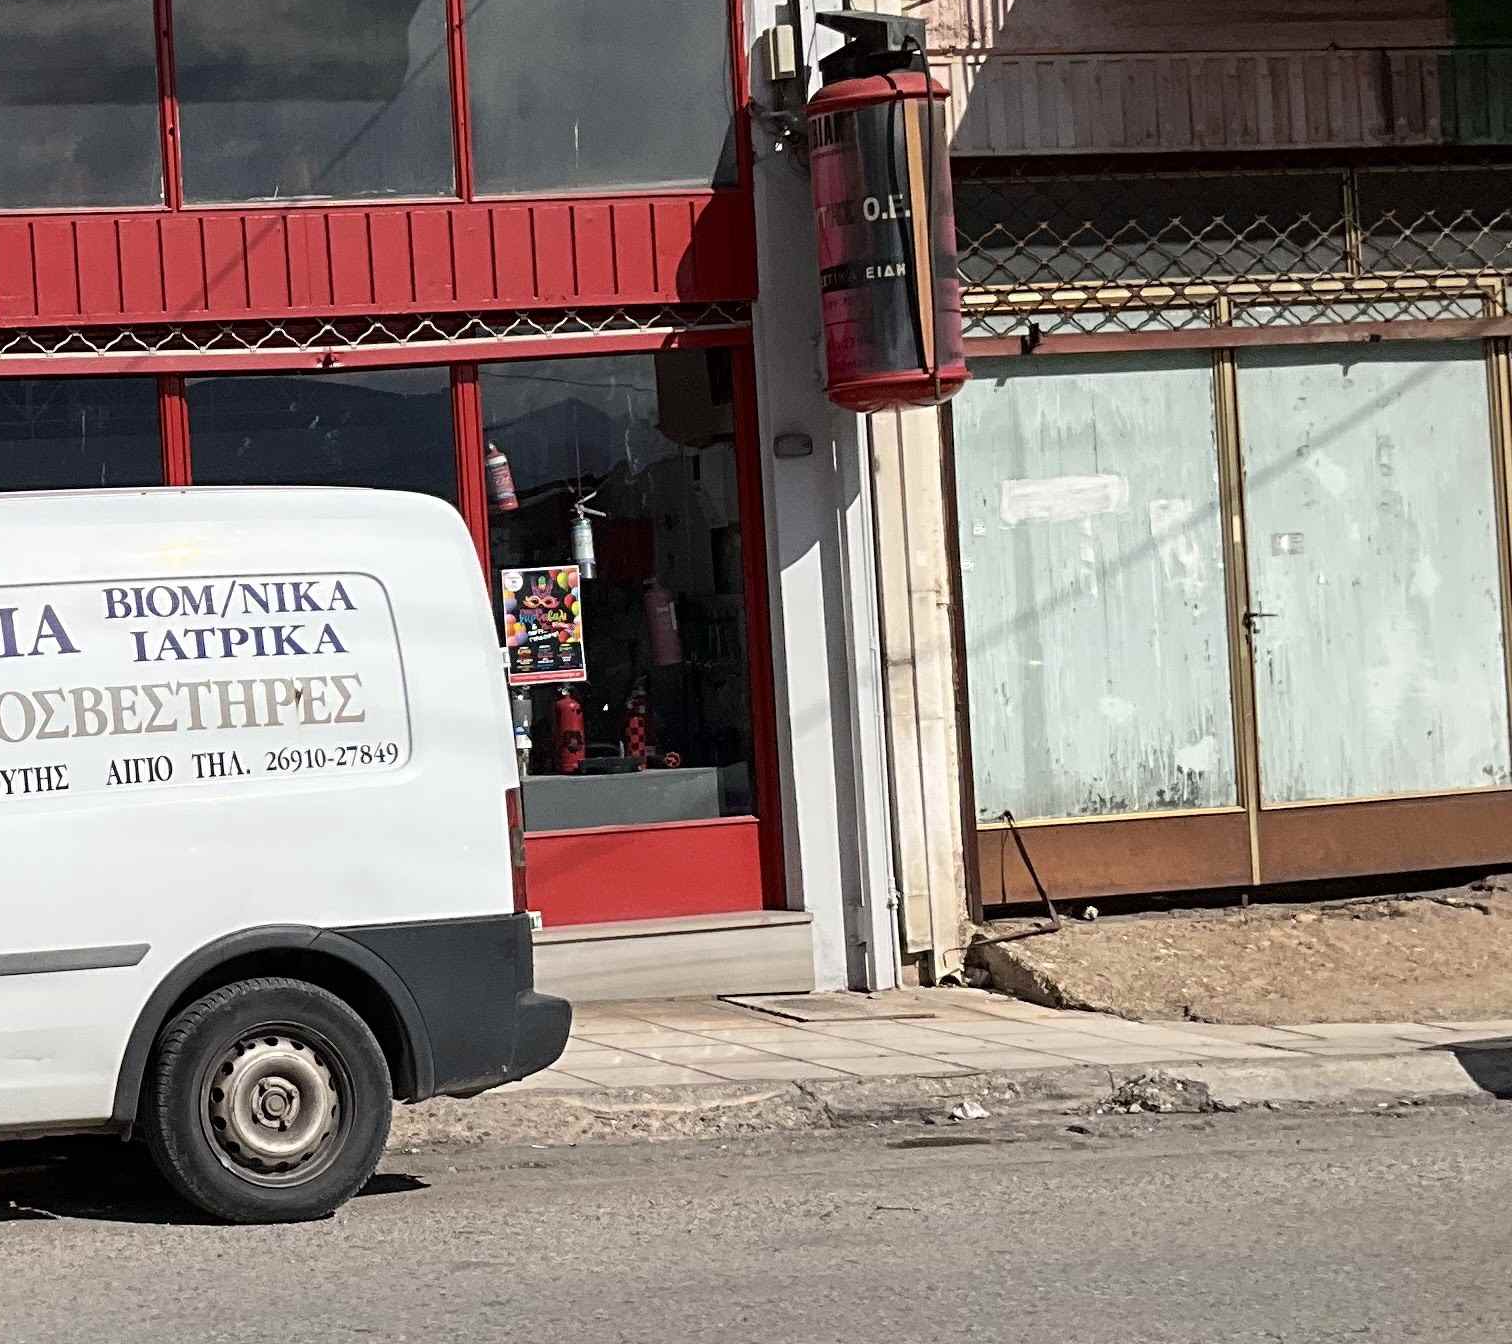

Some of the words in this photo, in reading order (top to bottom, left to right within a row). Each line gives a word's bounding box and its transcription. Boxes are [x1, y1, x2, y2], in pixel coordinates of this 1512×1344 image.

[865, 263, 906, 280] ΕΙΔΗ
[102, 579, 358, 620] ΒΙΟΜ/ΝΙΚΑ
[129, 622, 351, 663] ΙΑΤΡΙΚΑ
[105, 755, 174, 786] ΑΙΓΙΟ
[191, 750, 252, 780] ΤΗΛ.
[265, 741, 400, 773] 26910-27849
